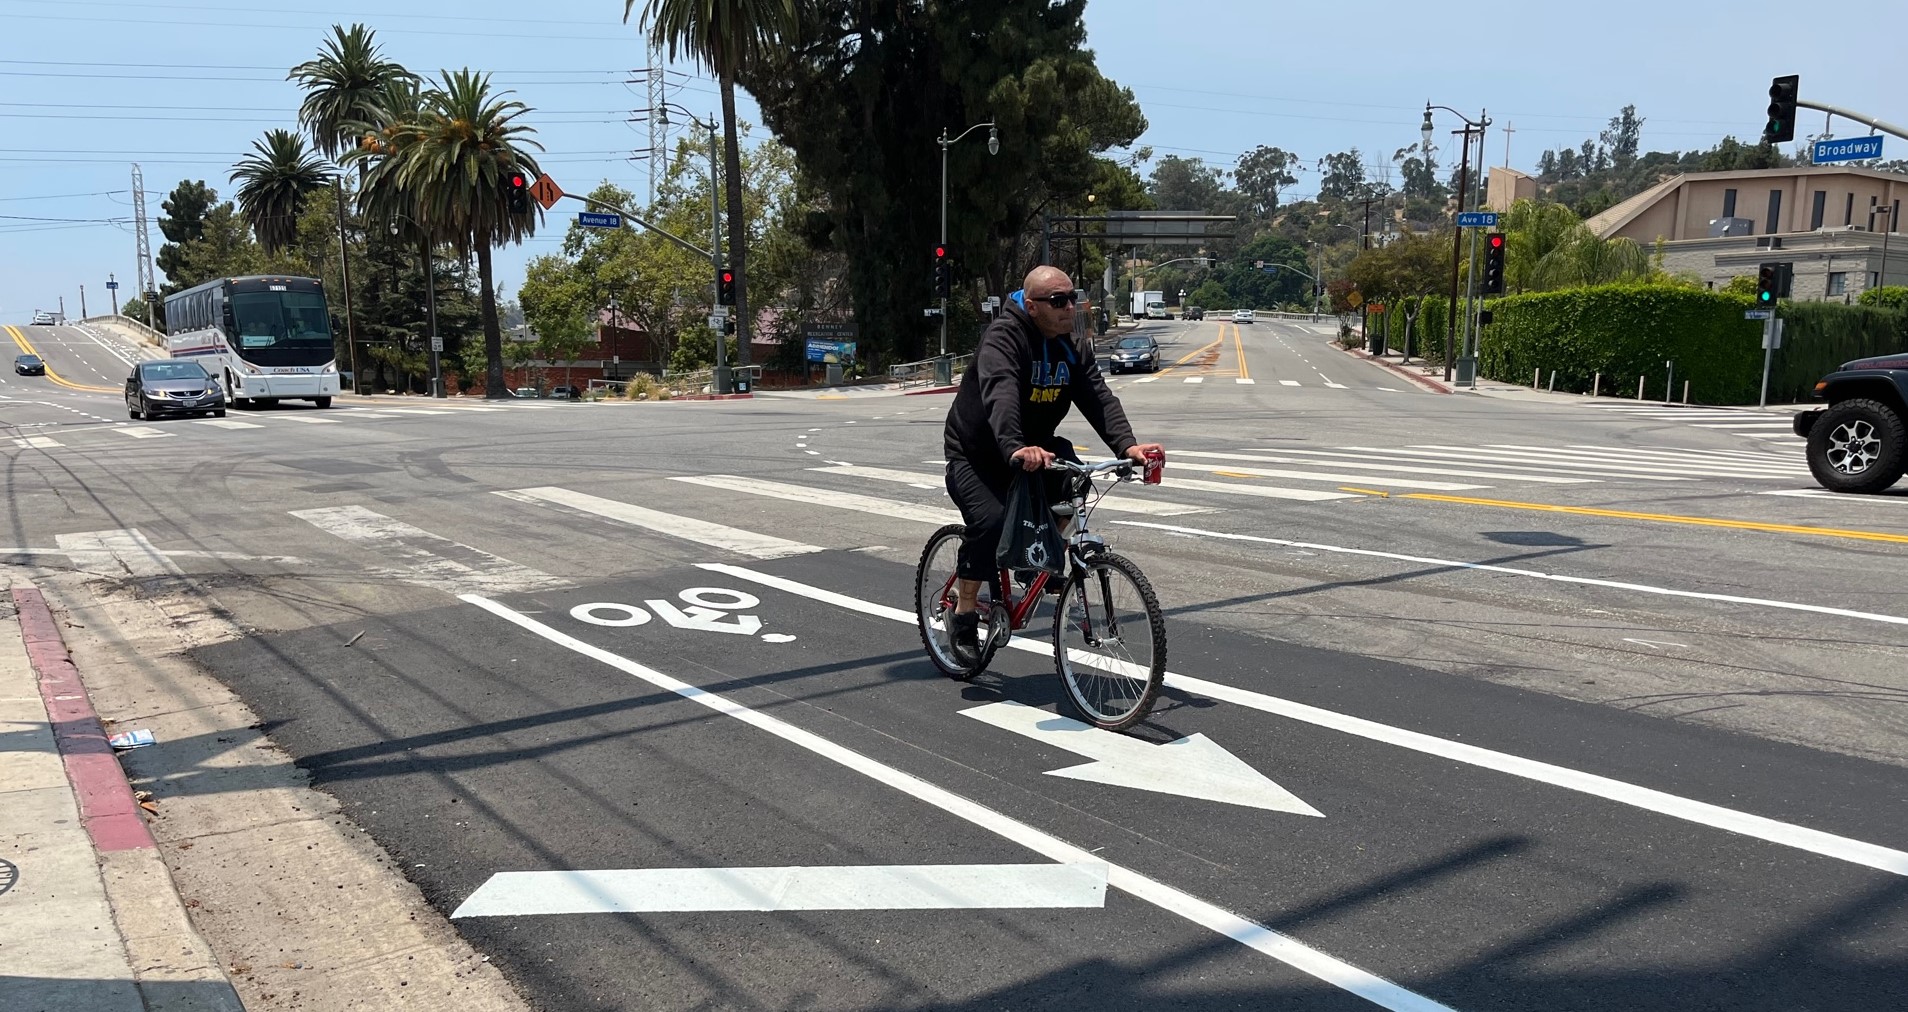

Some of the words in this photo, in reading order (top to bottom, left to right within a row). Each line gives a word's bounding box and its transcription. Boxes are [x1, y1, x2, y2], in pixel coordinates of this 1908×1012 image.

[1818, 142, 1878, 157] Broadway
[582, 215, 607, 225] Avenue
[609, 217, 617, 225] 18
[1461, 215, 1478, 224] Ave
[1482, 214, 1494, 224] 18
